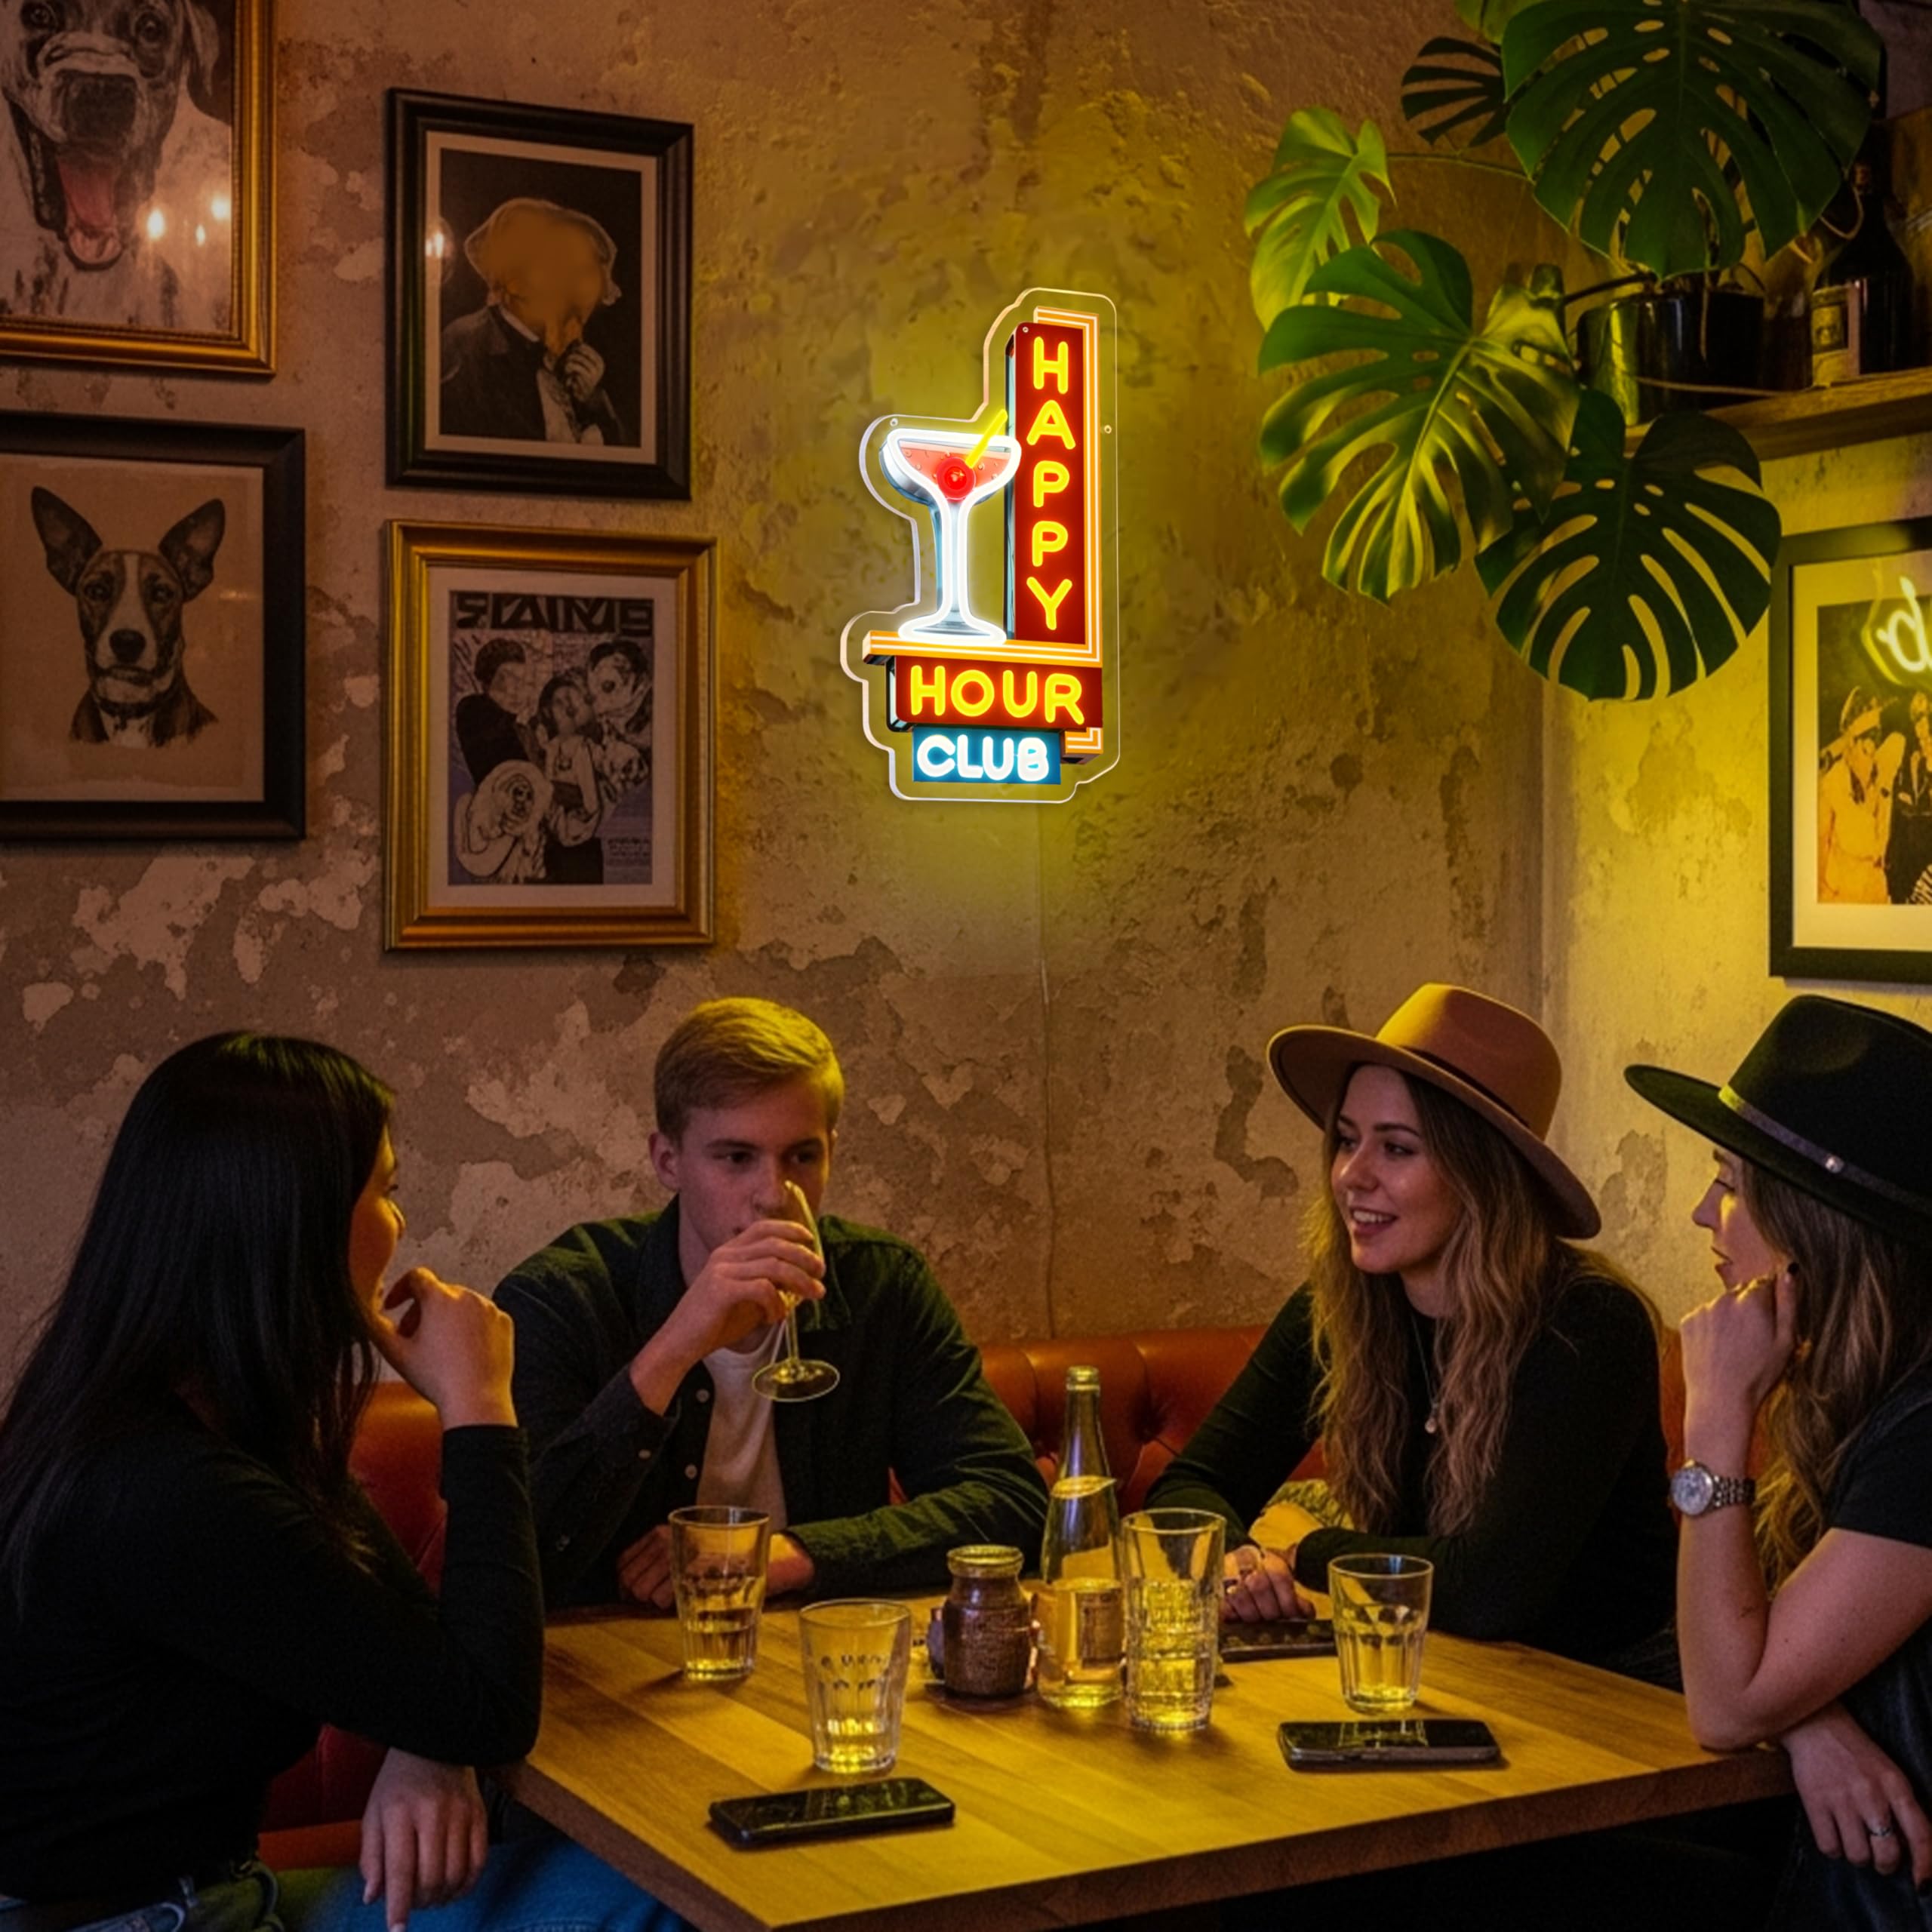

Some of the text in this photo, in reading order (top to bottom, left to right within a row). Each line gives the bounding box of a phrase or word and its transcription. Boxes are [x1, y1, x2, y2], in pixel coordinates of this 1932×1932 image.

[1026, 337, 1075, 631] HAPPY
[911, 665, 1084, 725] HOUR
[916, 734, 1050, 782] CLUB
